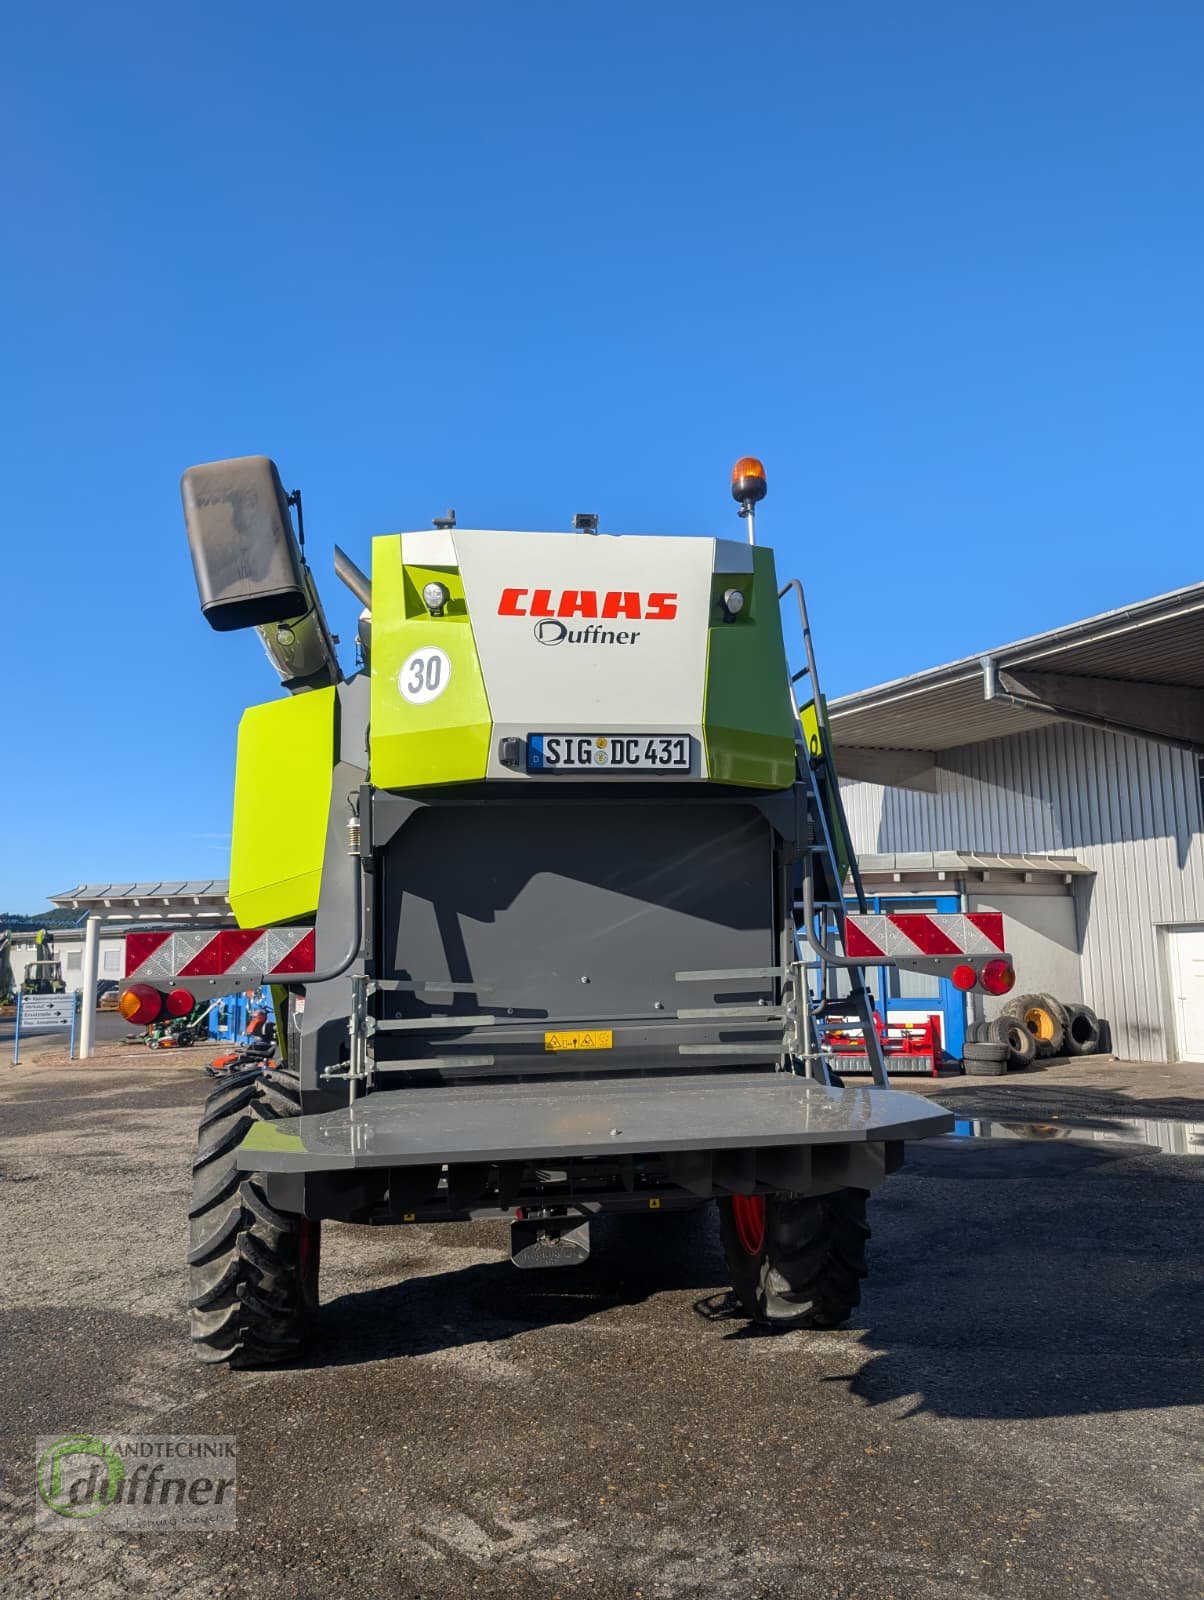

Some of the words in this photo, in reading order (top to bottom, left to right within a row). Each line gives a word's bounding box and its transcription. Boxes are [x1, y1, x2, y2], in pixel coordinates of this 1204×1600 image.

[497, 588, 678, 620] CLAAS
[534, 618, 641, 646] Duffner
[407, 655, 442, 694] 30
[546, 738, 592, 765] SIG
[610, 739, 640, 765] DC
[644, 739, 687, 765] 431
